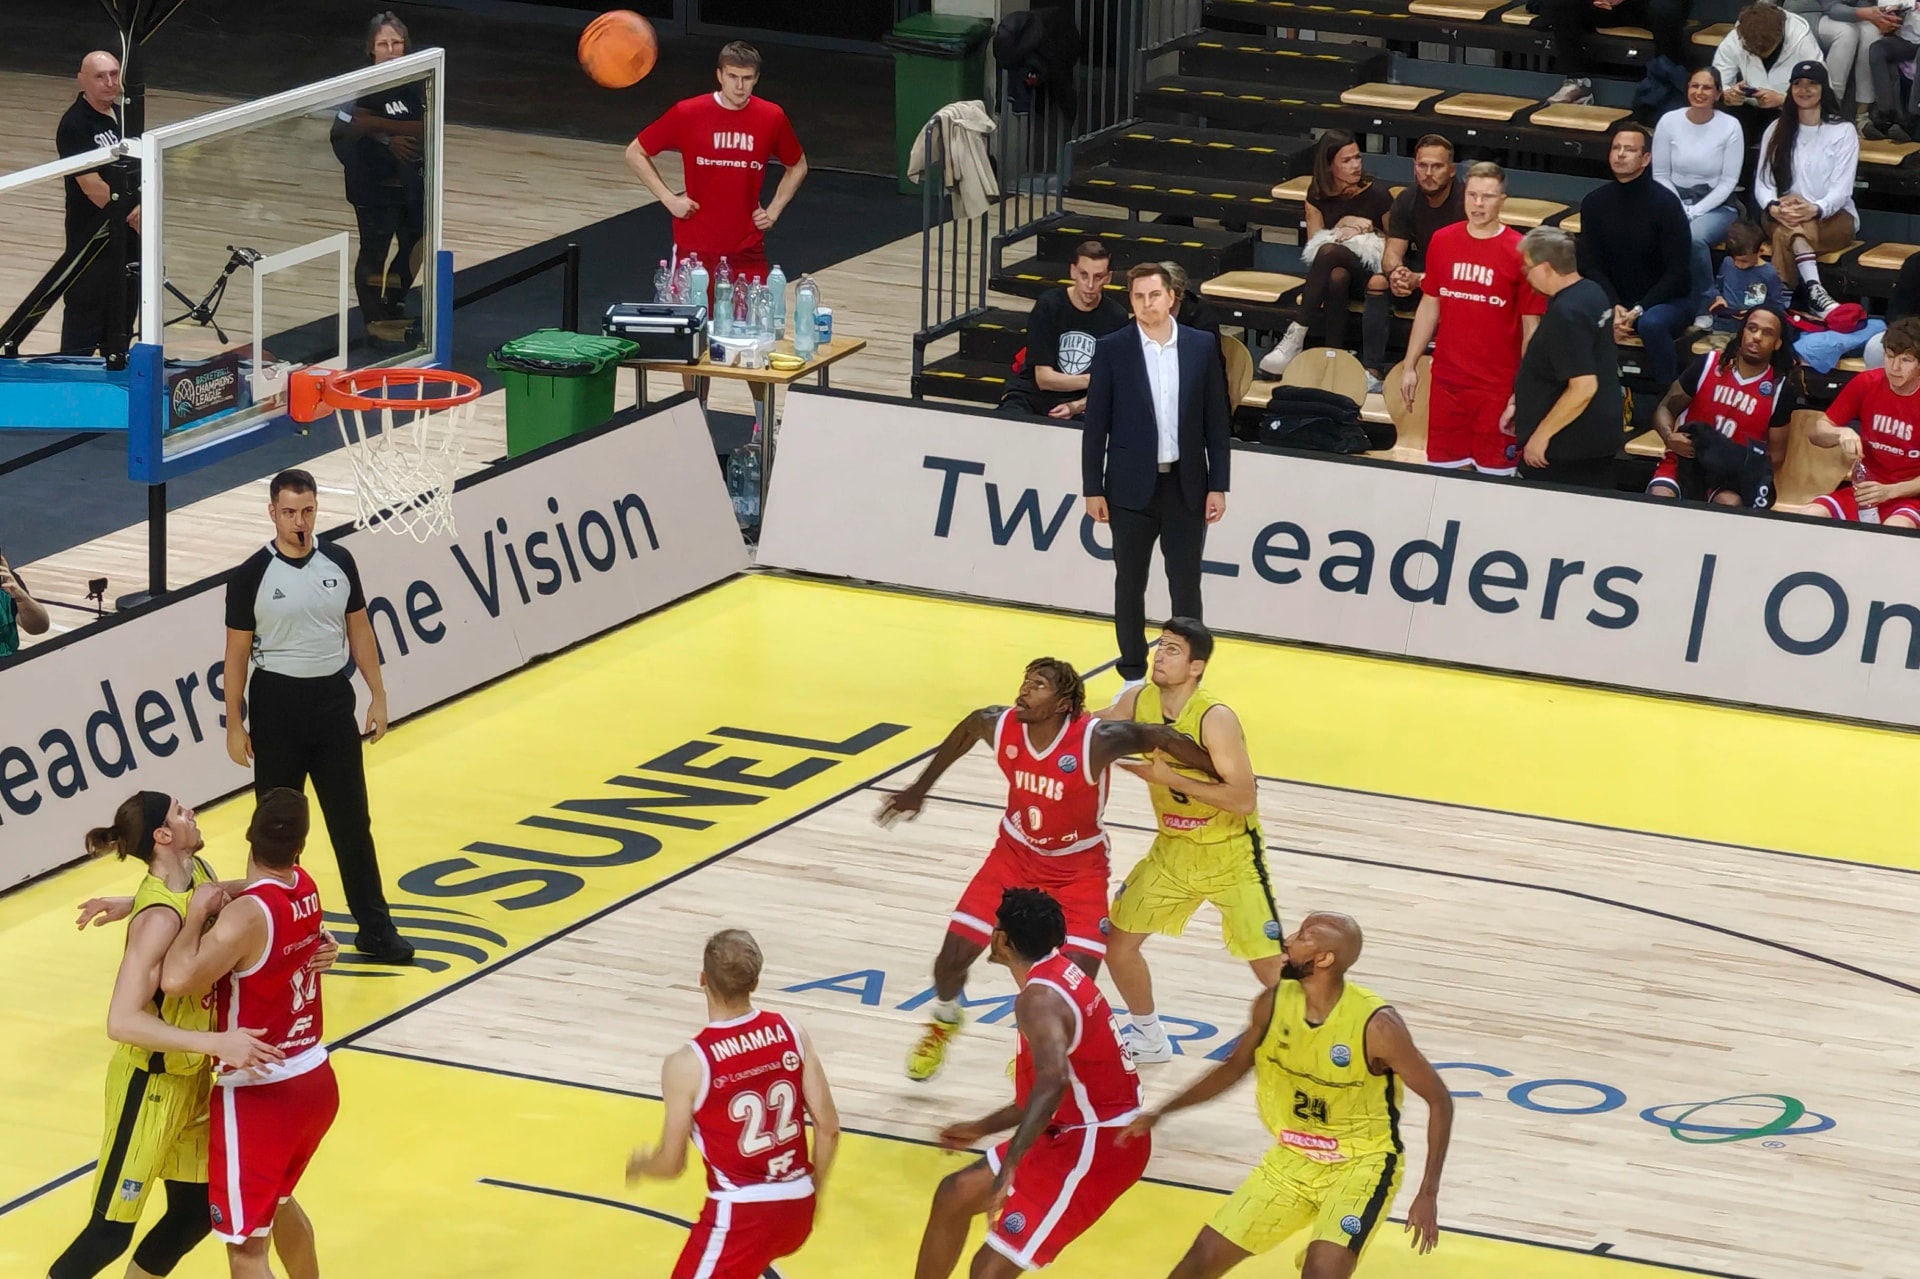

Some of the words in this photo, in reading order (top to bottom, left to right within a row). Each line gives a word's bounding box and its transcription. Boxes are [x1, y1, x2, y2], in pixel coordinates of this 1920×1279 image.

[713, 131, 754, 152] VILPAS
[750, 160, 764, 171] Oy
[1452, 262, 1495, 287] VILPAS
[1488, 295, 1507, 308] Oy
[1062, 335, 1094, 354] VILPAS
[195, 373, 235, 396] CHAMPIONS
[195, 387, 223, 407] LEAGUE
[1712, 384, 1758, 416] VILPAS
[1872, 413, 1914, 442] VILPAS
[347, 579, 447, 681] ne
[449, 492, 660, 619] Vision
[1014, 769, 1065, 802] VILPAS
[397, 721, 912, 912] SUNEL
[1027, 805, 1043, 832] 0
[709, 1023, 789, 1063] INNAMAA
[727, 1079, 802, 1158] 22
[1292, 1088, 1329, 1124] 24
